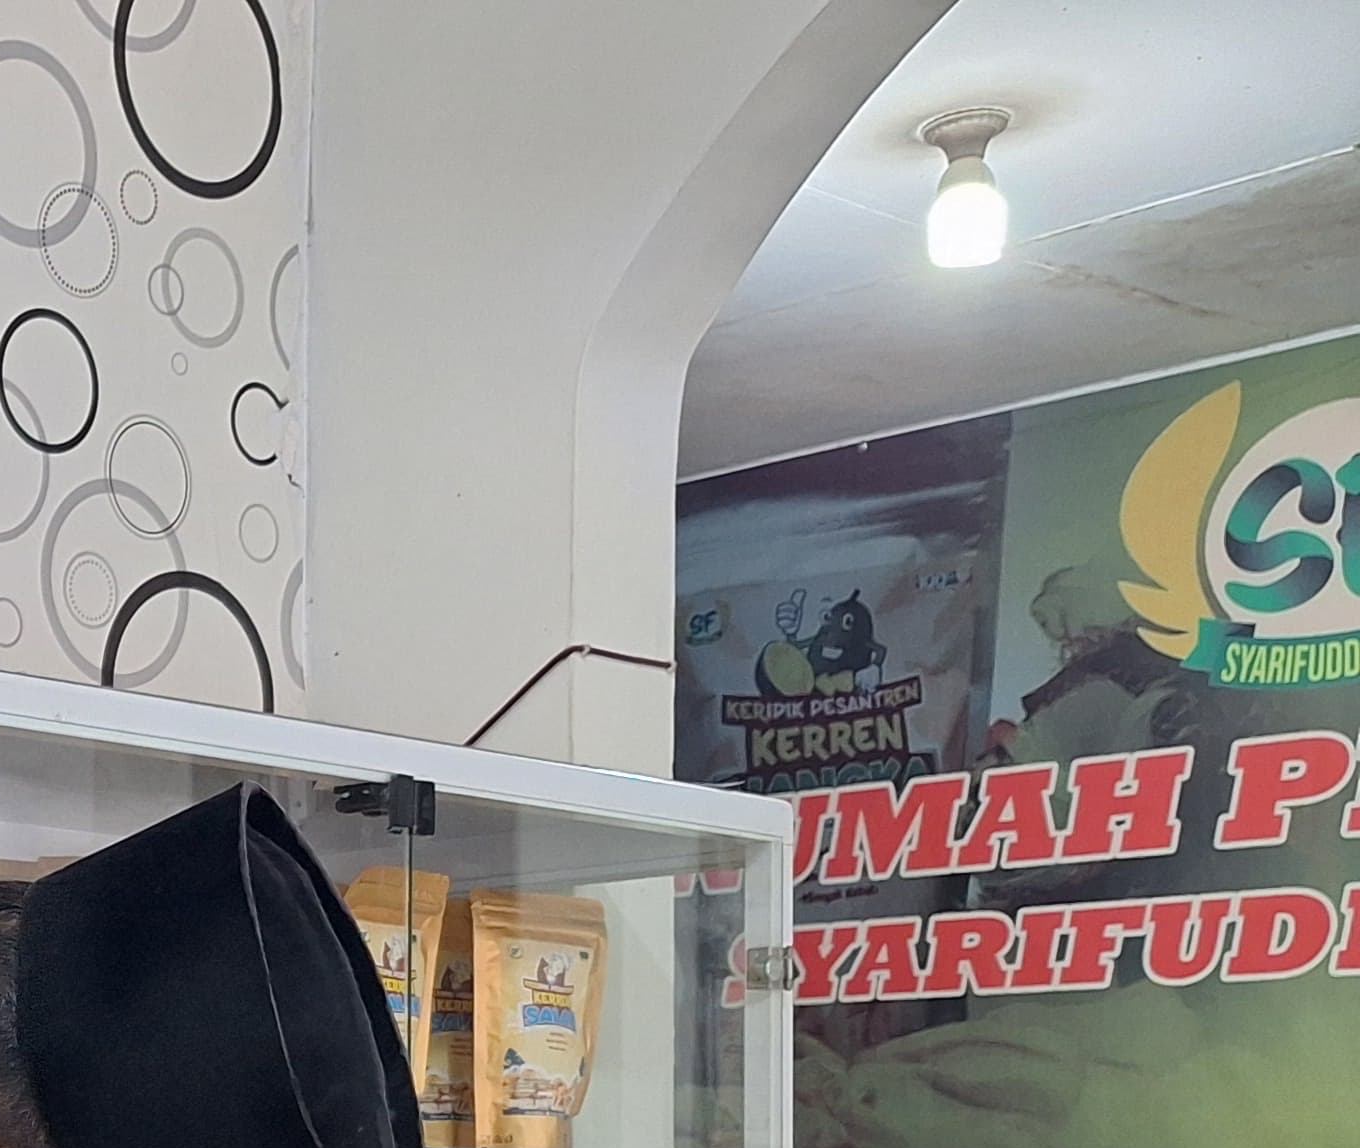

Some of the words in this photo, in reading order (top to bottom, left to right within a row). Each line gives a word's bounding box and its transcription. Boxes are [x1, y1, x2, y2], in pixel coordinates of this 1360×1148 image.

[690, 610, 718, 635] SF
[1221, 638, 1360, 684] SYARIFUDD
[727, 699, 805, 721] KERIPIK
[810, 682, 920, 716] PESANTREN
[752, 713, 904, 767] KERREN
[674, 745, 1194, 896] UMAH
